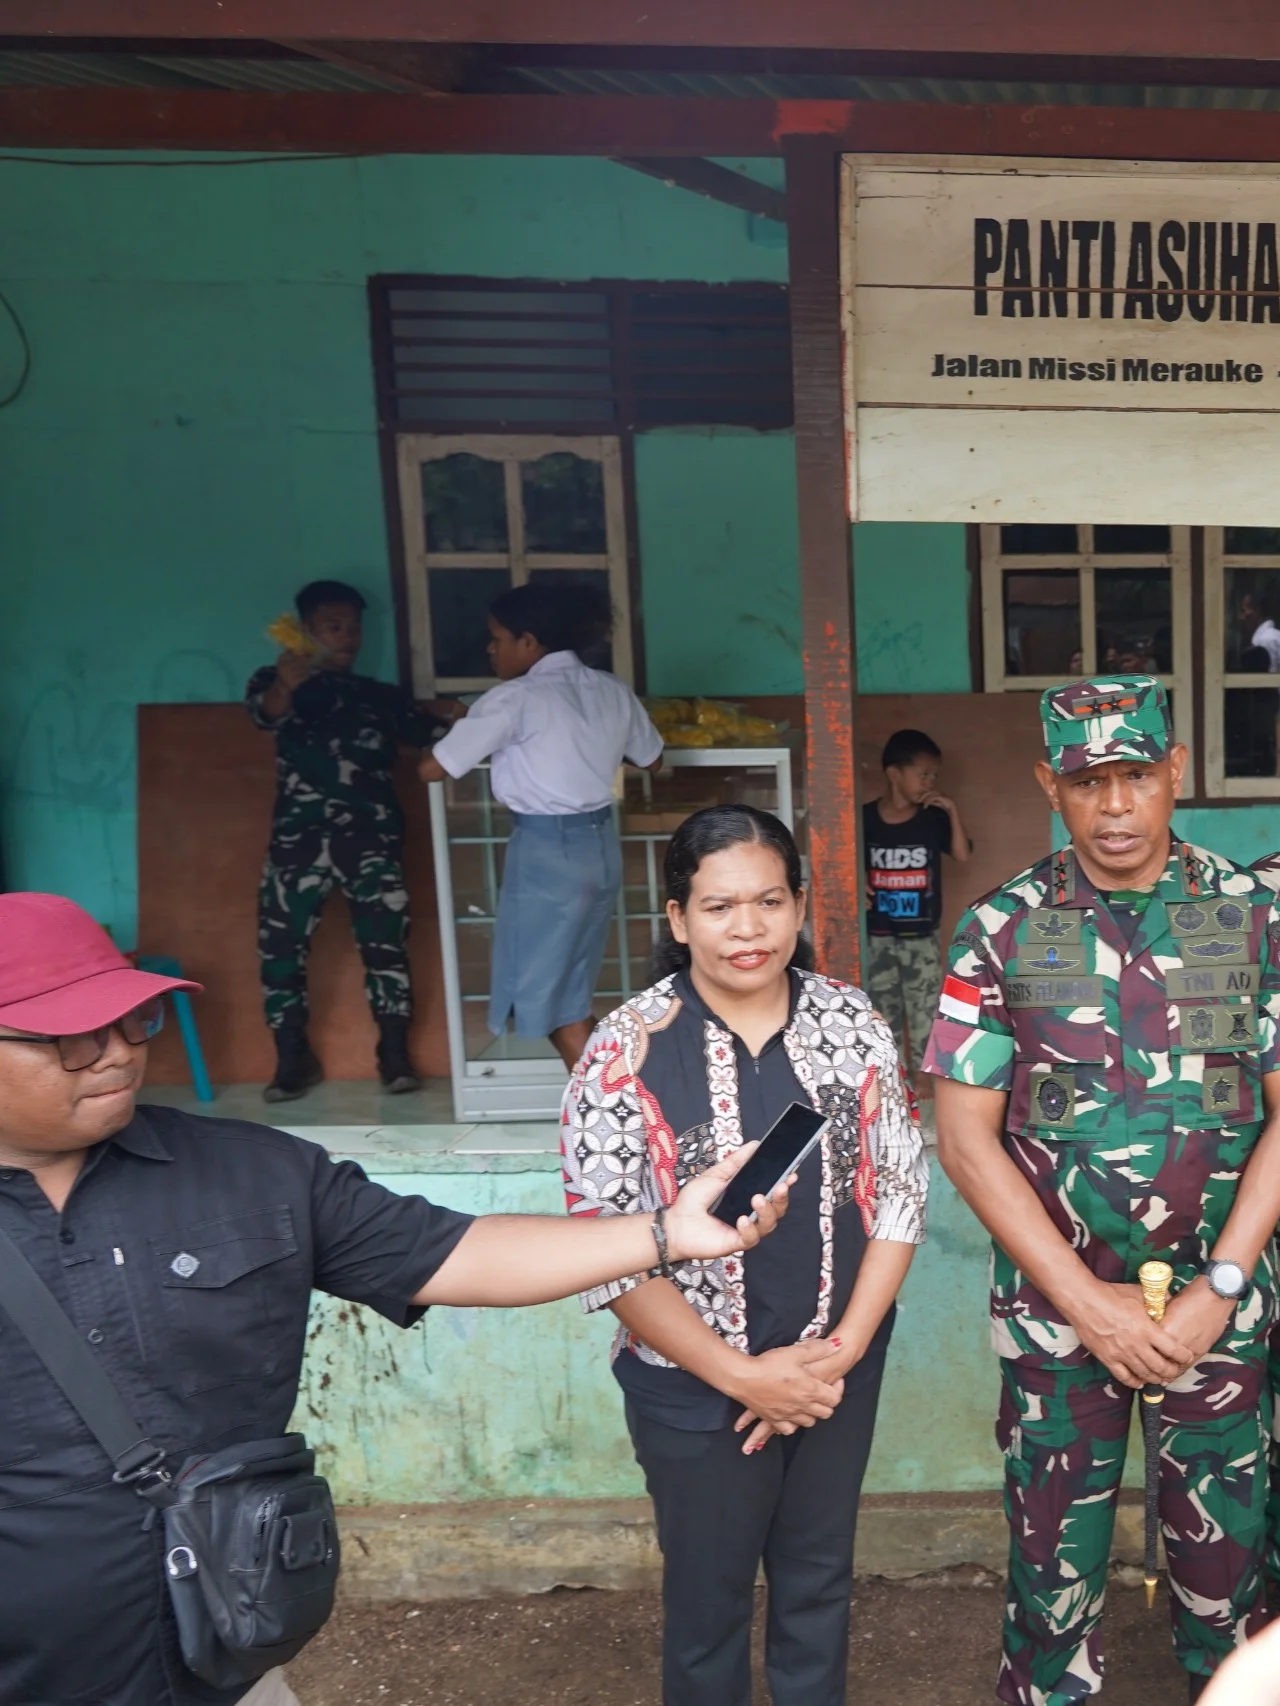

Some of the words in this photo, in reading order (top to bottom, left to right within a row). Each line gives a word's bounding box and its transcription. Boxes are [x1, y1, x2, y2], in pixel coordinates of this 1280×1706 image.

[973, 216, 1117, 319] PANTI
[931, 353, 1022, 380] Jalan
[1028, 356, 1117, 382] Missi
[1121, 358, 1264, 384] Merauke
[870, 846, 928, 870] KIDS
[1179, 971, 1216, 992] TNI
[1226, 970, 1252, 991] AD
